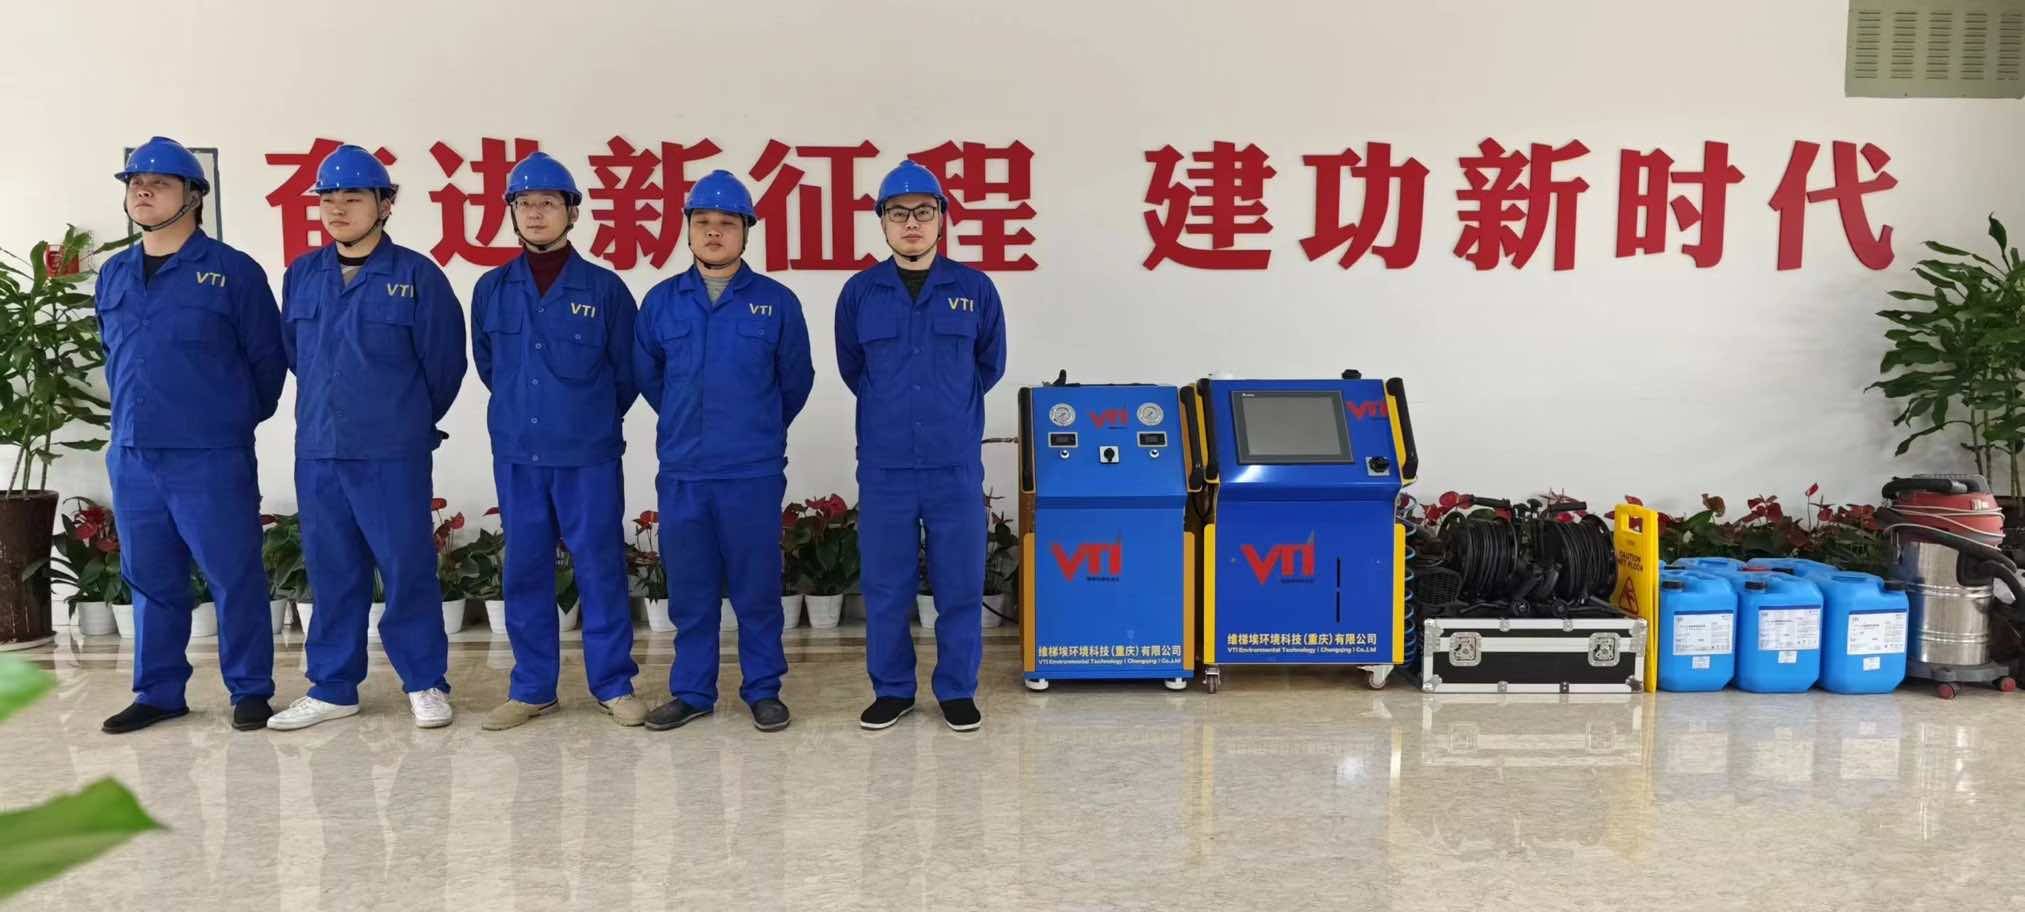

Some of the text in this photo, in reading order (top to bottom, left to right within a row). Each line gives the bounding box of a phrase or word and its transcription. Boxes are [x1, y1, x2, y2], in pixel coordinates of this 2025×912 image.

[264, 136, 1899, 273] 奋进新征程 建功新时代
[195, 270, 226, 288] VTI
[386, 282, 414, 298] VTI
[569, 302, 596, 318] VTI
[749, 302, 772, 317] VTI
[948, 296, 974, 313] VTI
[1088, 407, 1129, 428] VTI
[1051, 541, 1122, 582] VTI
[1241, 541, 1316, 584] VTI
[1619, 551, 1641, 562] CAUTION
